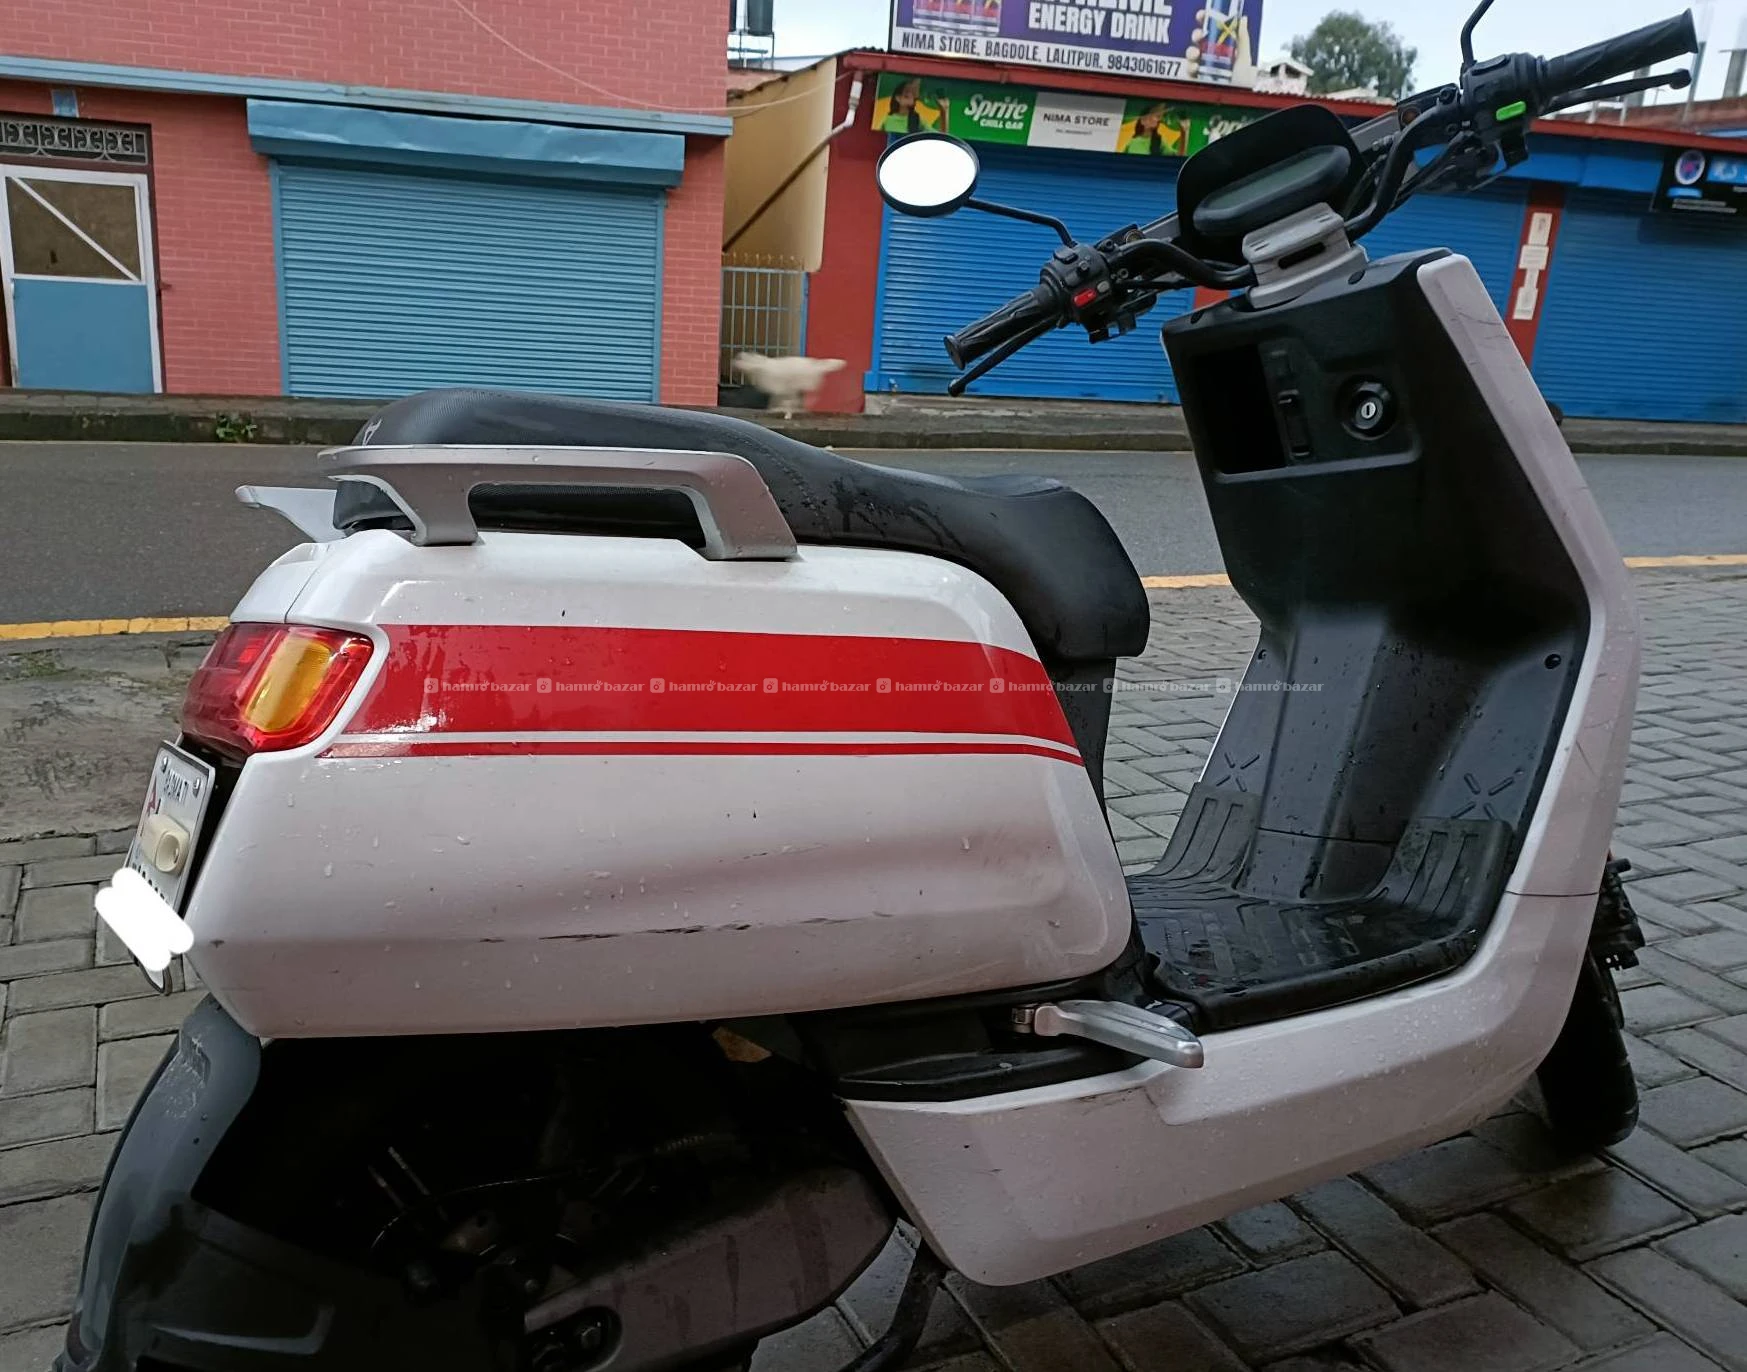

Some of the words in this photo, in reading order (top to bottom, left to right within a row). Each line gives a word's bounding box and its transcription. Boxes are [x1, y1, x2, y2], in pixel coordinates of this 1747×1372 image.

[1028, 2, 1106, 36] ENERGY
[1110, 11, 1171, 44] DRINK
[902, 31, 935, 51] NIMA
[1107, 54, 1181, 76] 9843061677
[964, 93, 1028, 121] Sprite
[1043, 113, 1071, 124] NIMA
[1074, 115, 1110, 127] STORE
